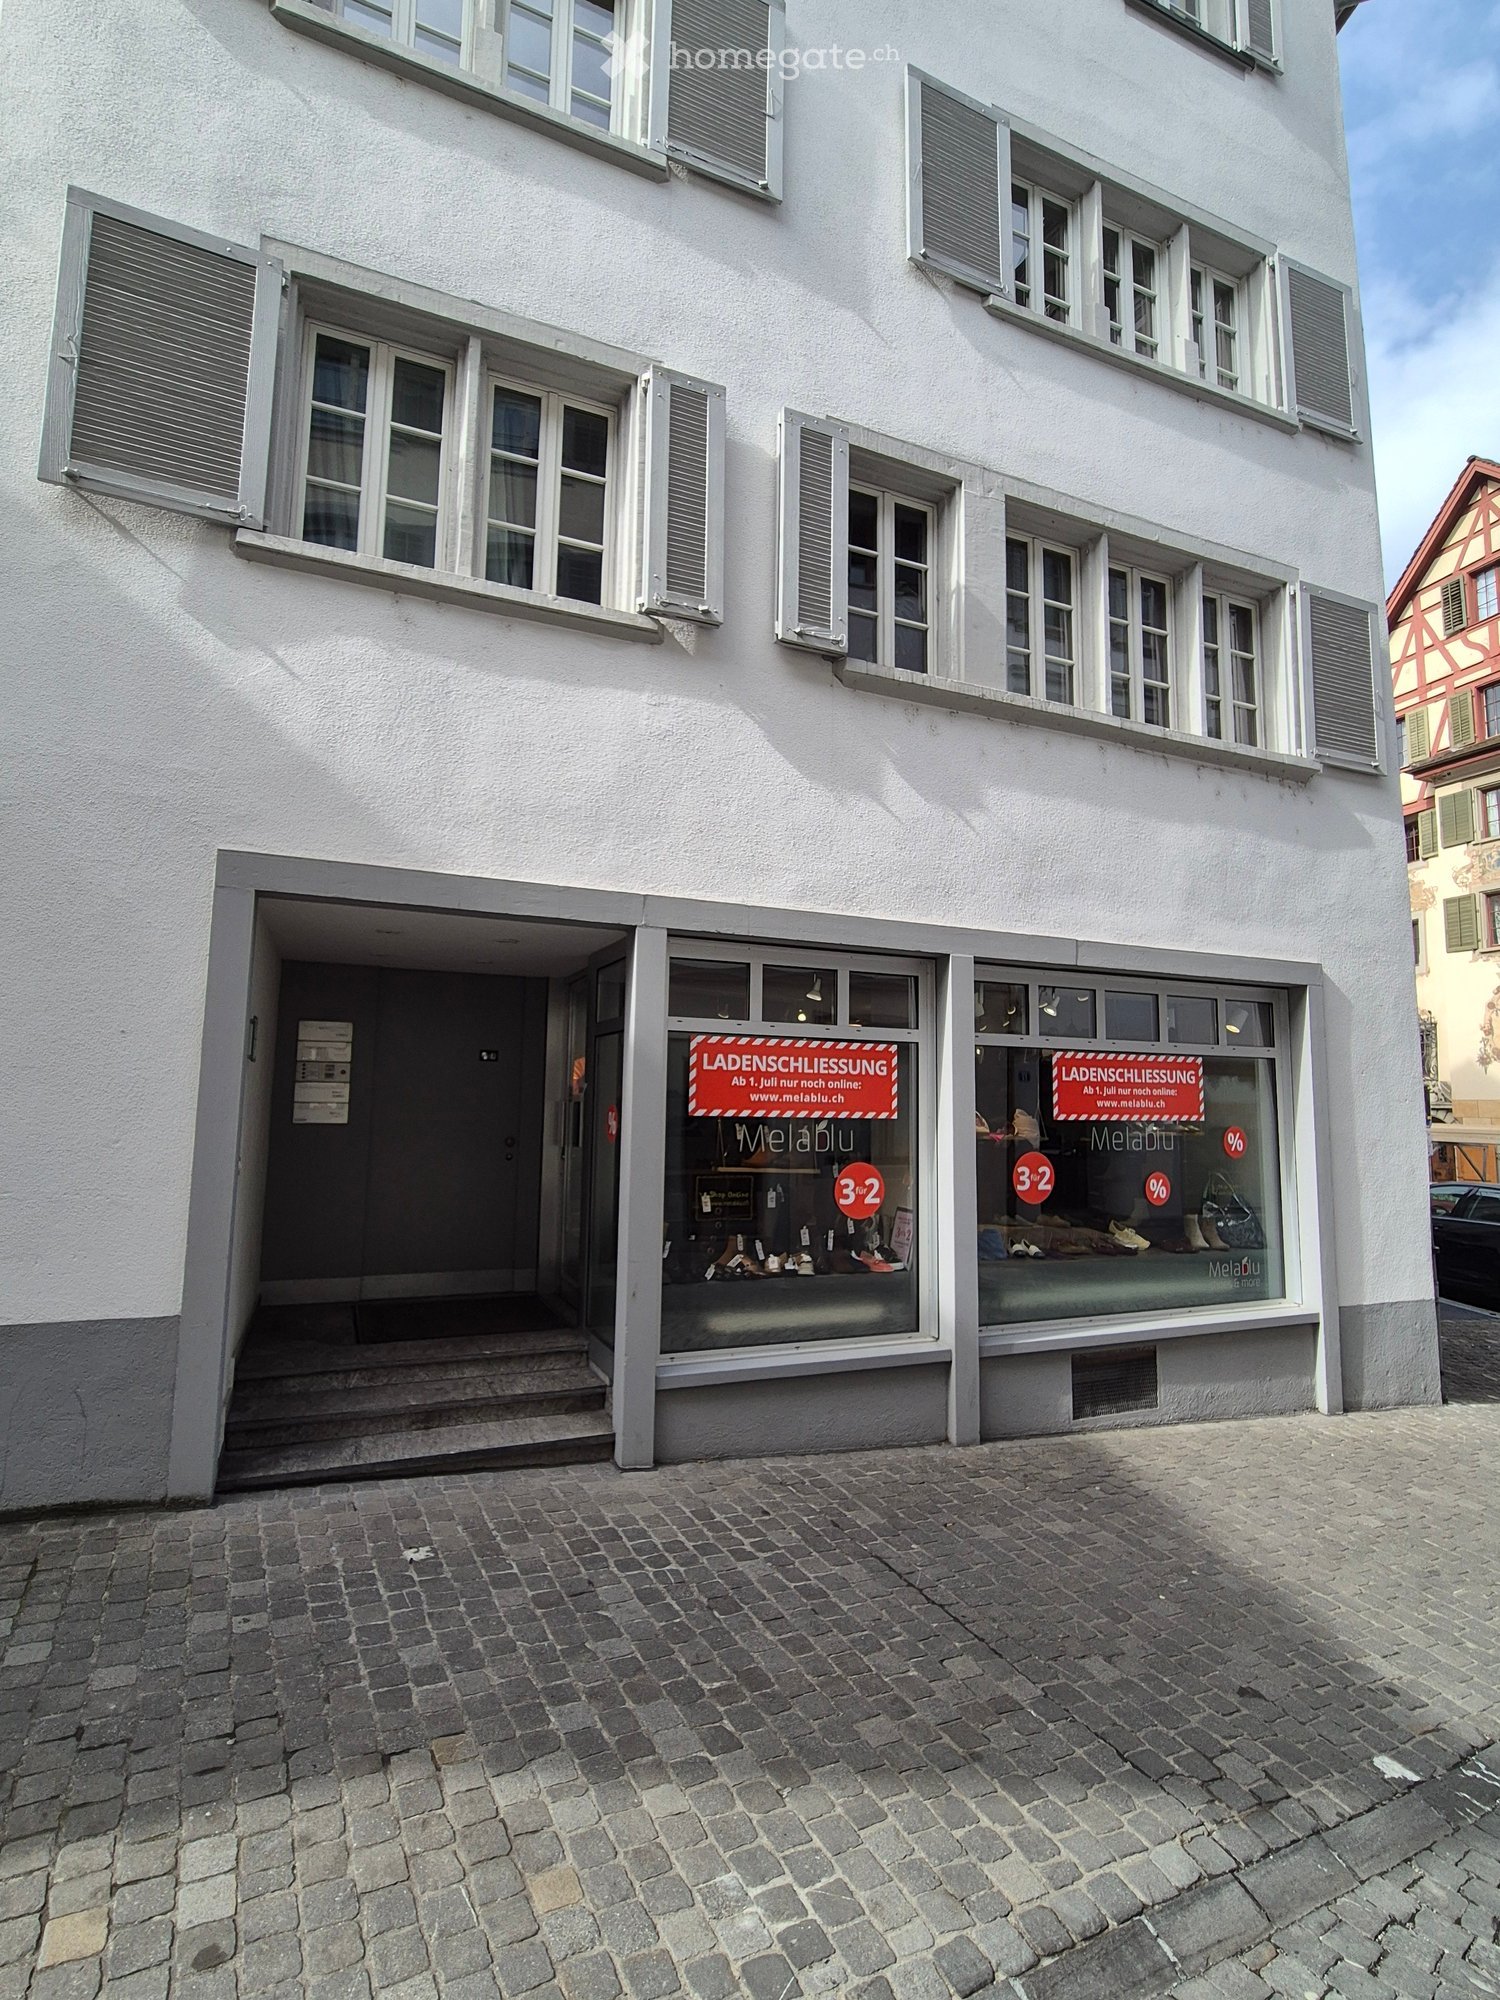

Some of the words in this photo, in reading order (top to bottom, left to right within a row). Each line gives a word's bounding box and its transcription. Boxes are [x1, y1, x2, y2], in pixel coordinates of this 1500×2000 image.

[702, 1053, 888, 1076] LADENSCHLIESSUNG
[731, 1076, 747, 1087] Ab
[749, 1077, 758, 1087] 1.
[759, 1077, 778, 1089] Juli
[780, 1079, 799, 1088] nur
[800, 1078, 825, 1089] noch
[828, 1079, 862, 1090] online:
[1061, 1066, 1196, 1084] LADENSCHLIESSUNG
[750, 1092, 845, 1104] www.melablu.ch
[1083, 1086, 1094, 1095] Ab
[1095, 1086, 1102, 1095] 1.
[1103, 1086, 1117, 1096] Juli
[1118, 1088, 1131, 1096] nur
[1133, 1087, 1151, 1096] noch
[1152, 1087, 1178, 1096] online:
[1096, 1099, 1166, 1109] www.melablu.ch
[739, 1120, 854, 1153] Melablu
[1090, 1126, 1174, 1151] Melablu
[1227, 1132, 1244, 1152] %
[1149, 1178, 1167, 1199] %
[1209, 1256, 1260, 1277] Melablu
[1241, 1278, 1261, 1288] more
